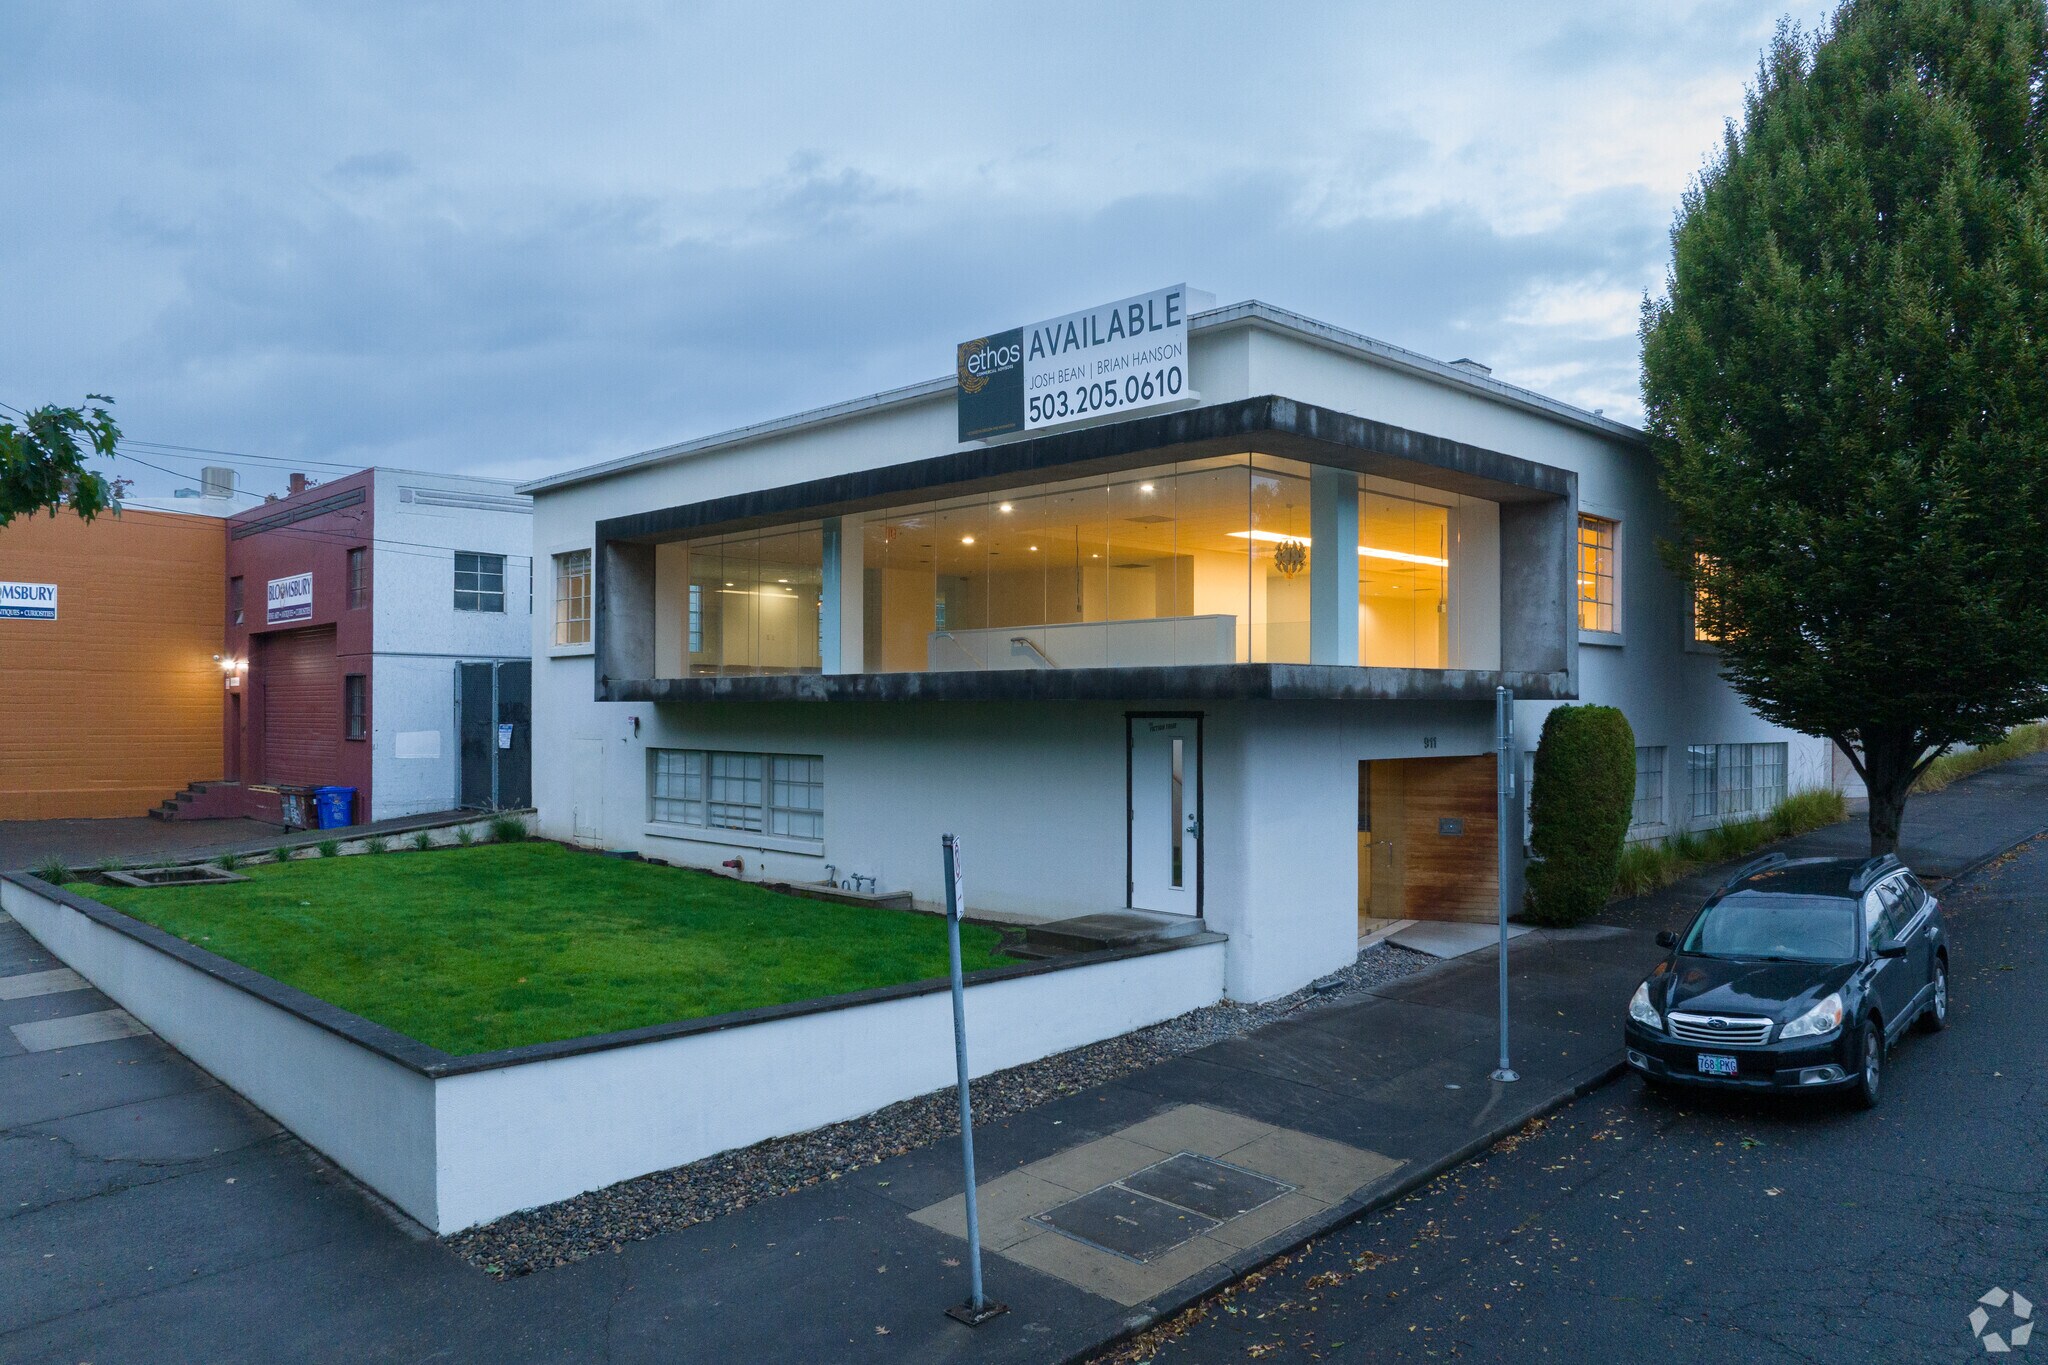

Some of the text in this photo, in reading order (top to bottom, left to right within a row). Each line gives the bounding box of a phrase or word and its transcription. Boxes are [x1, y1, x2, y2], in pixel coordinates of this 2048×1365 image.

[1028, 292, 1182, 362] AVAILABLE
[967, 344, 1020, 374] ethos
[1029, 342, 1182, 390] JOSH BEAN BRIAN HANSON
[1029, 366, 1182, 423] 503.205.0610
[24, 609, 55, 617] CURIOSITIES
[1423, 736, 1437, 749] 911
[1698, 1058, 1736, 1071] 768 PKG
